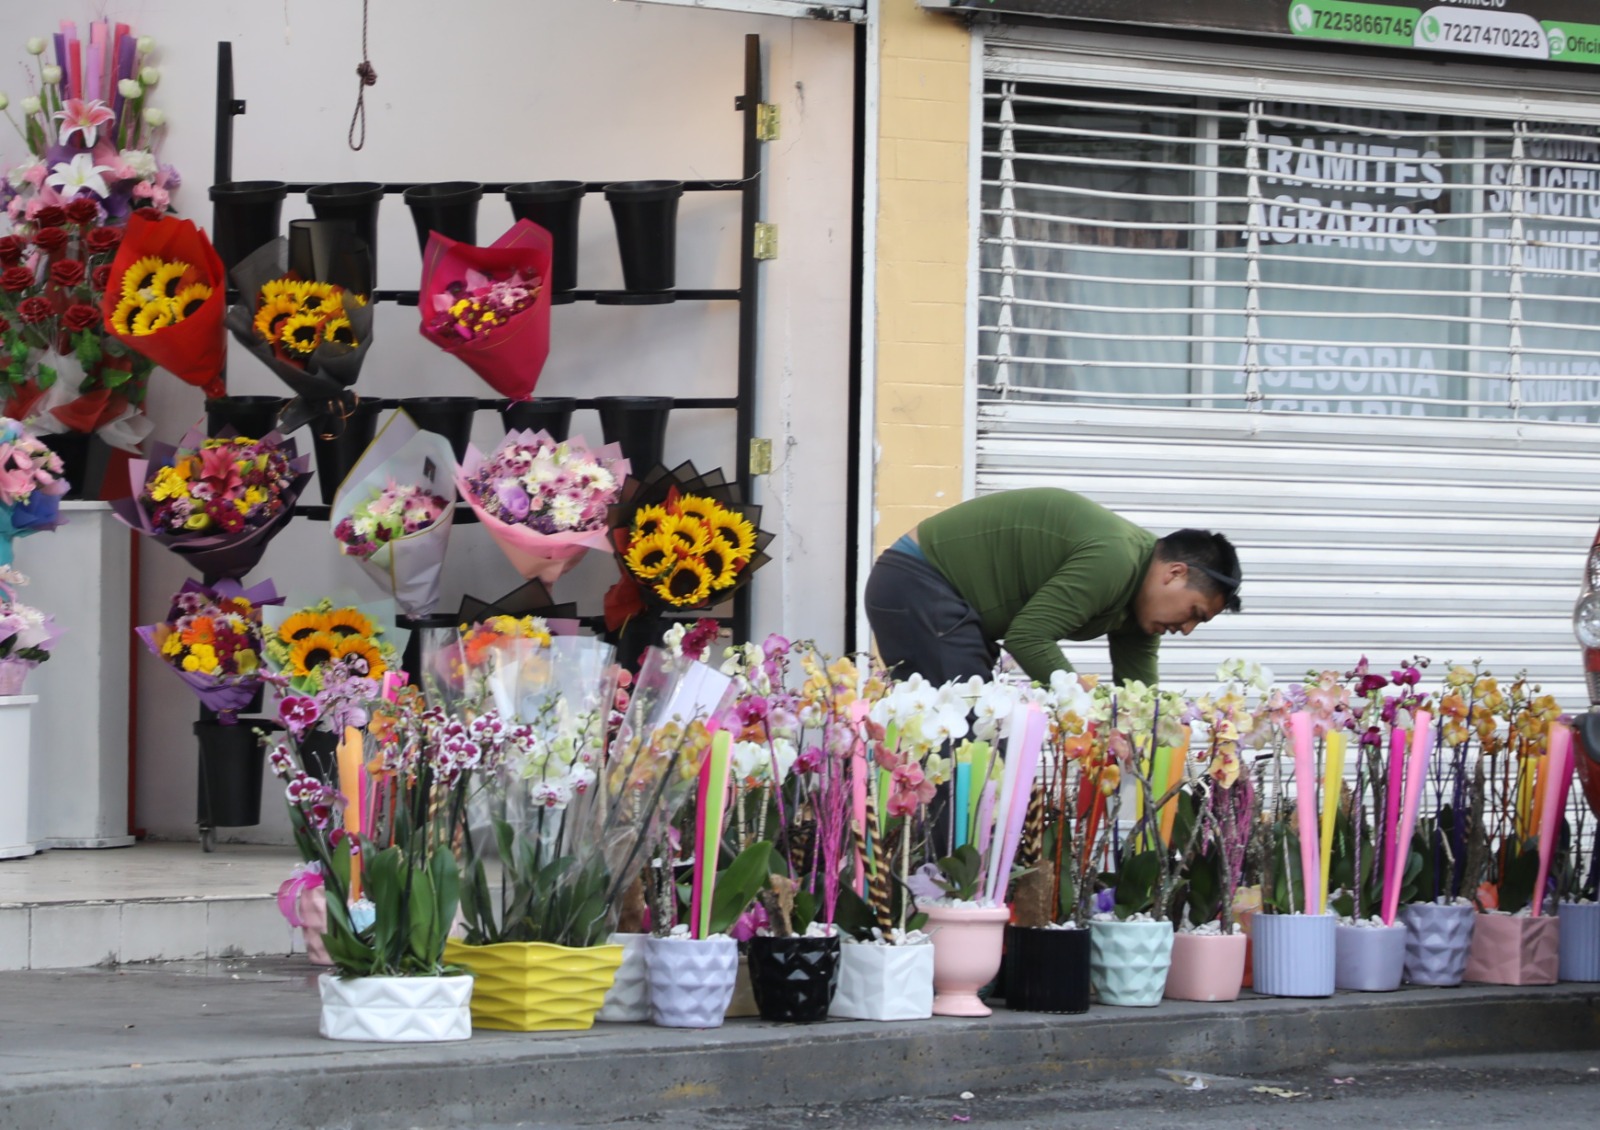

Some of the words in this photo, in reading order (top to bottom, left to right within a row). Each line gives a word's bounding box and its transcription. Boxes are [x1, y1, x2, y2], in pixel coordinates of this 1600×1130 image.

[1312, 9, 1413, 38] 7225866745
[1443, 22, 1540, 49] 7227470223
[1233, 343, 1440, 398] ASESORIA
